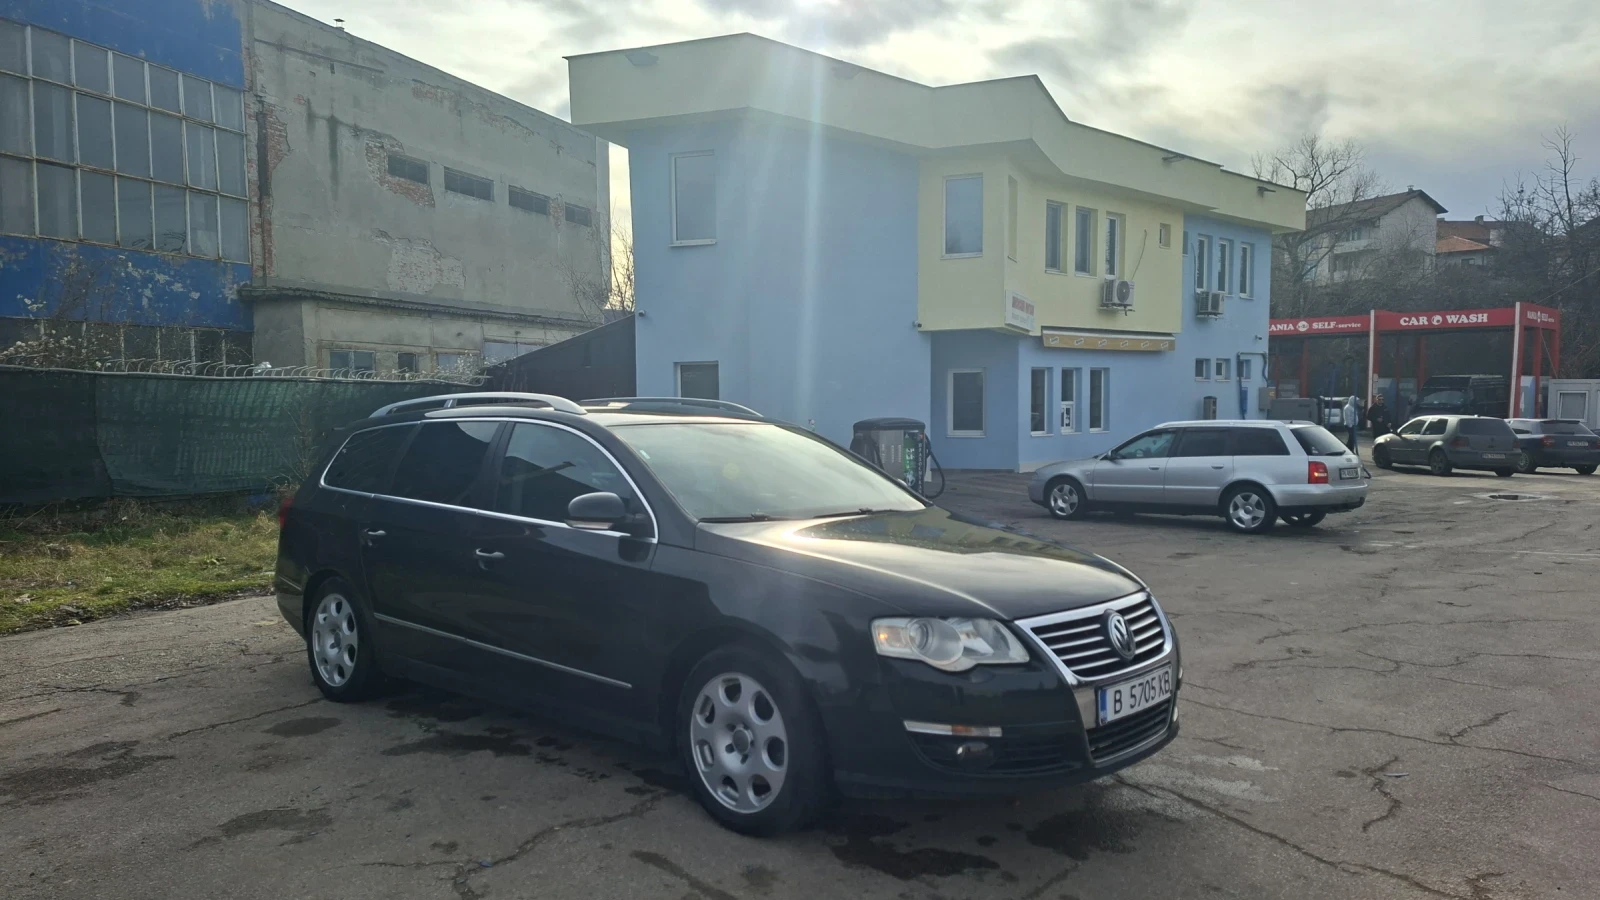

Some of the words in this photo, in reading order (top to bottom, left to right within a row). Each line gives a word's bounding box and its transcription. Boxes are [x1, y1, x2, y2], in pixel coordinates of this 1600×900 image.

[1399, 316, 1429, 326] CAR
[1445, 313, 1489, 324] WASH
[1268, 323, 1295, 332] ANIA
[1113, 689, 1123, 715] B
[1129, 676, 1157, 709] 5705
[1158, 670, 1171, 698] XB
